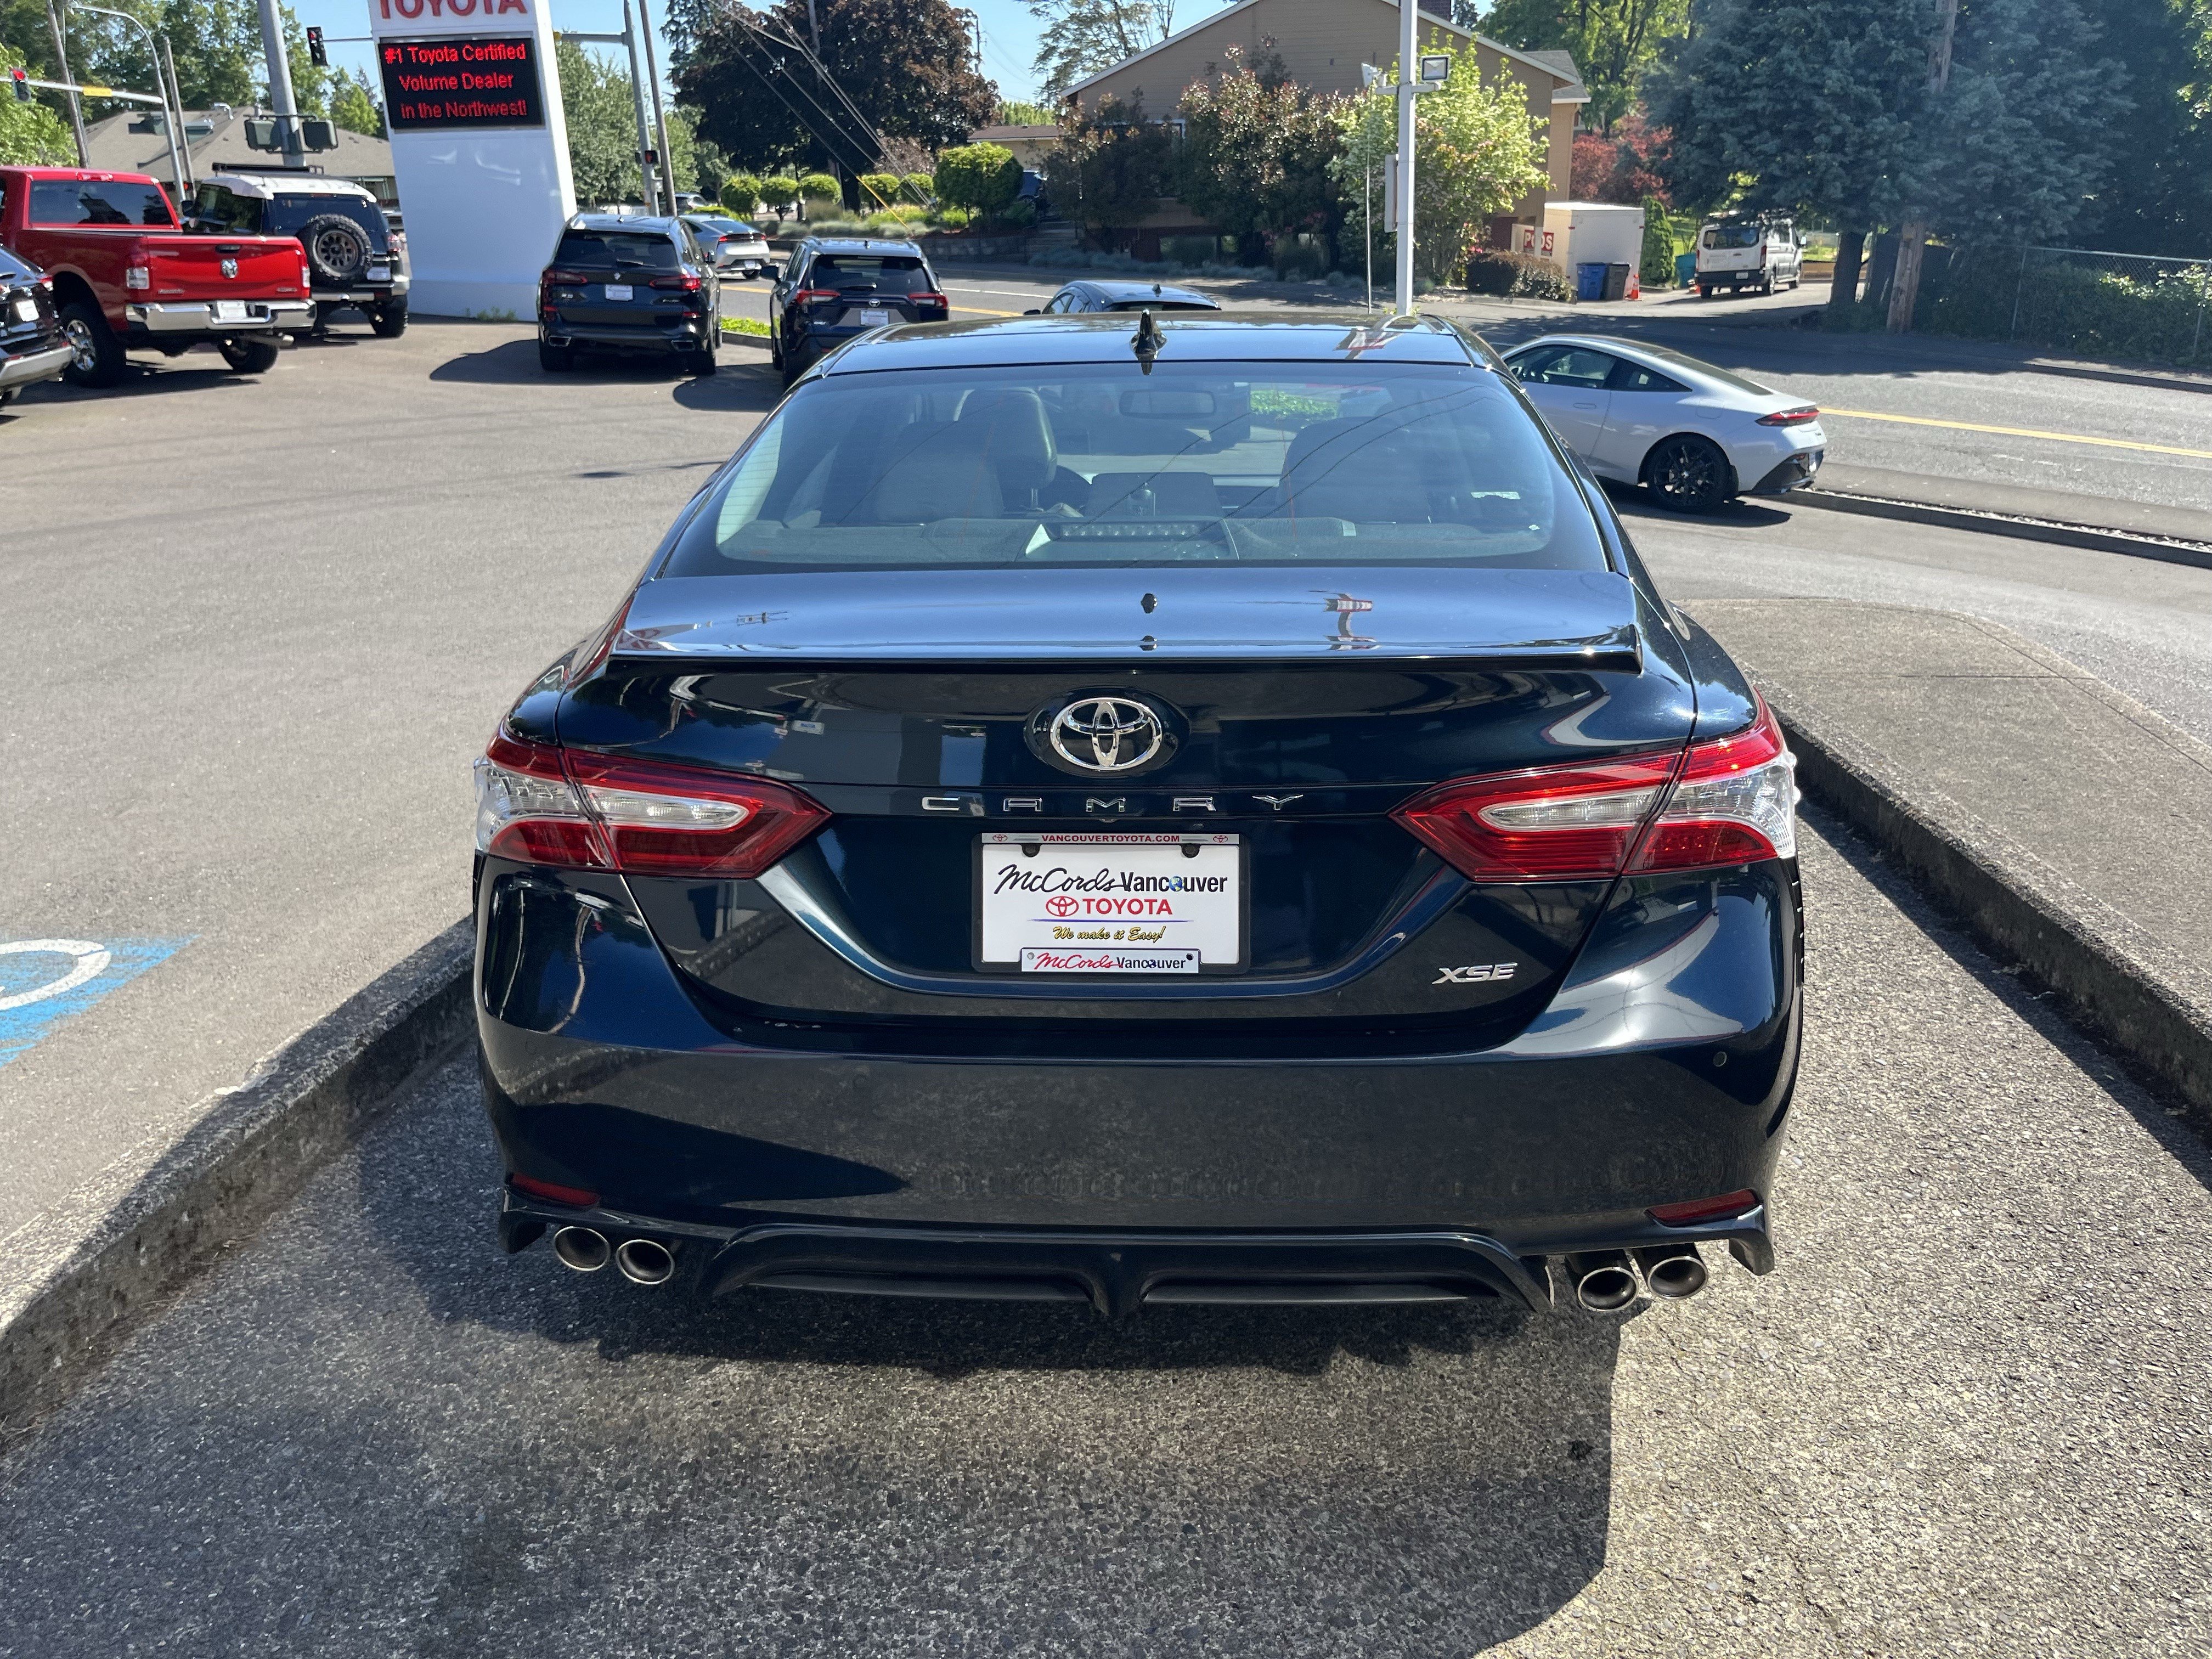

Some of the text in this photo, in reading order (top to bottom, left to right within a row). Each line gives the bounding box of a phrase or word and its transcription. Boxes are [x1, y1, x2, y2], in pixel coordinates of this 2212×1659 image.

[384, 42, 527, 66] #1 Toyota Certified
[398, 71, 514, 92] Volume Dealer
[400, 98, 527, 119] in the Northwest!
[922, 794, 1304, 812] CAMRY
[1041, 834, 1181, 843] VANCOUVERTOYOTA.COM
[1119, 871, 1228, 893] Vancouver
[1082, 897, 1173, 915] TOYOTA
[1053, 926, 1166, 943] We make it Easy!
[1431, 962, 1518, 985] XSE
